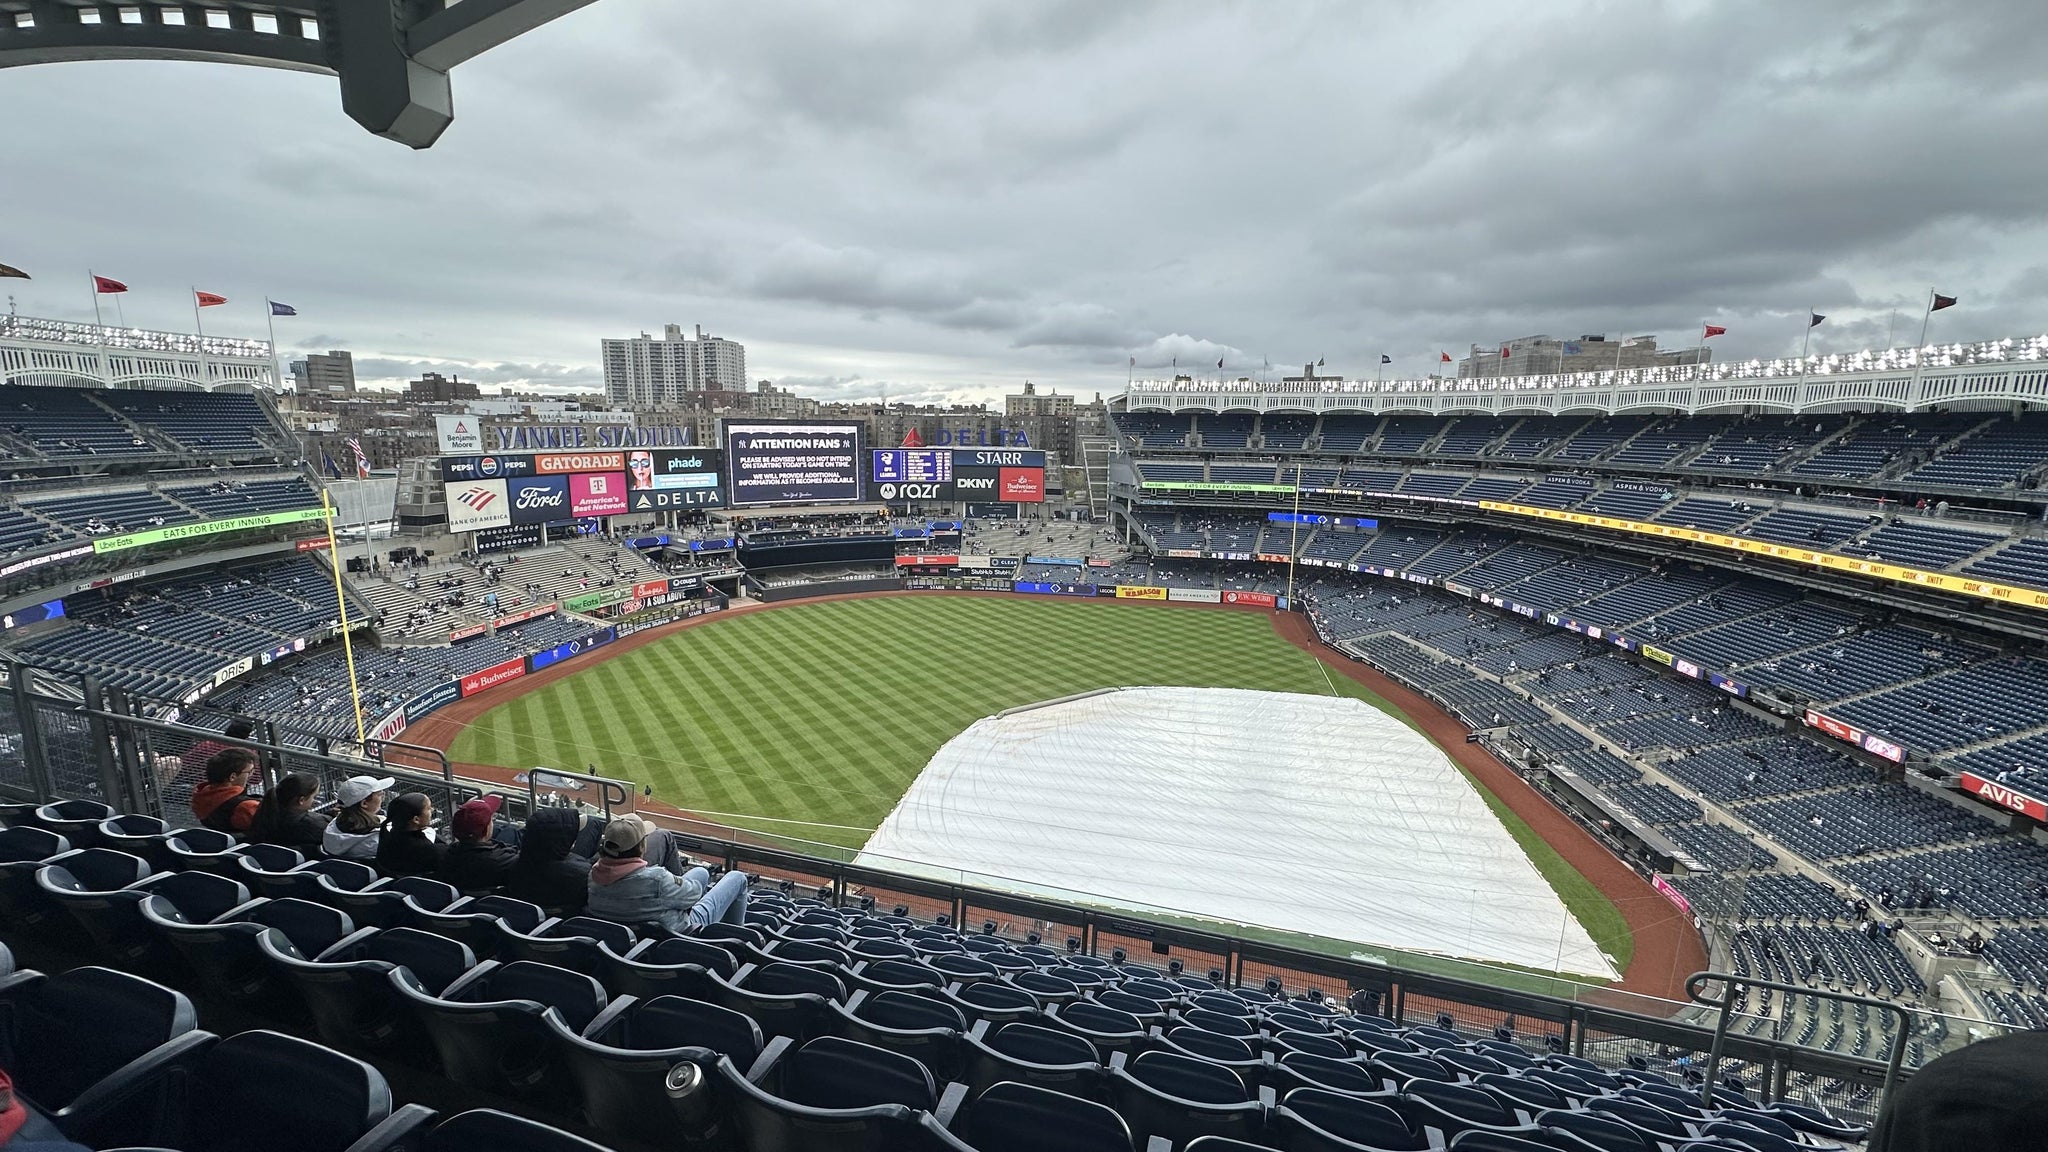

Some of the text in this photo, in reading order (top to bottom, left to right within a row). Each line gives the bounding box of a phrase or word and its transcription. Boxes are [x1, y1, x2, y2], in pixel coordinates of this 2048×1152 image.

[447, 434, 477, 443] Benjamin
[497, 426, 693, 449] YANKEE STADIUM
[750, 439, 841, 449] ATTENTION FANS
[936, 429, 1031, 447] DELTA
[540, 455, 621, 471] GATORADE
[668, 456, 702, 472] phade
[976, 452, 1022, 465] STARR
[451, 464, 474, 472] PEPSI
[957, 478, 995, 489] DKNY
[516, 487, 563, 509] Ford
[657, 490, 720, 506] DELTA
[900, 484, 941, 499] razr
[573, 502, 627, 512] Best Network
[579, 496, 620, 505] America's
[317, 508, 334, 516] Eas
[450, 518, 469, 526] BANK
[479, 514, 509, 523] AMERICA
[163, 516, 271, 539] EATS FOR EVERY INNING
[99, 537, 133, 550] Uber Eats
[1802, 552, 1834, 565] COOK UNITY
[1848, 561, 1885, 574] COOK UNITY
[679, 578, 697, 586] coupa
[1902, 570, 1944, 585] COOK UNITY
[1963, 582, 2012, 598] COOK UNITY
[582, 598, 599, 608] Eats
[647, 599, 652, 607] A
[653, 595, 666, 606] SUB
[667, 592, 686, 602] ABOVE
[1251, 594, 1271, 602] WEBB
[2034, 594, 2048, 605] COO
[221, 662, 245, 682] ORIS
[480, 665, 523, 687] Budweiser
[433, 687, 457, 701] Einstein
[1978, 783, 2027, 811] AVIS
